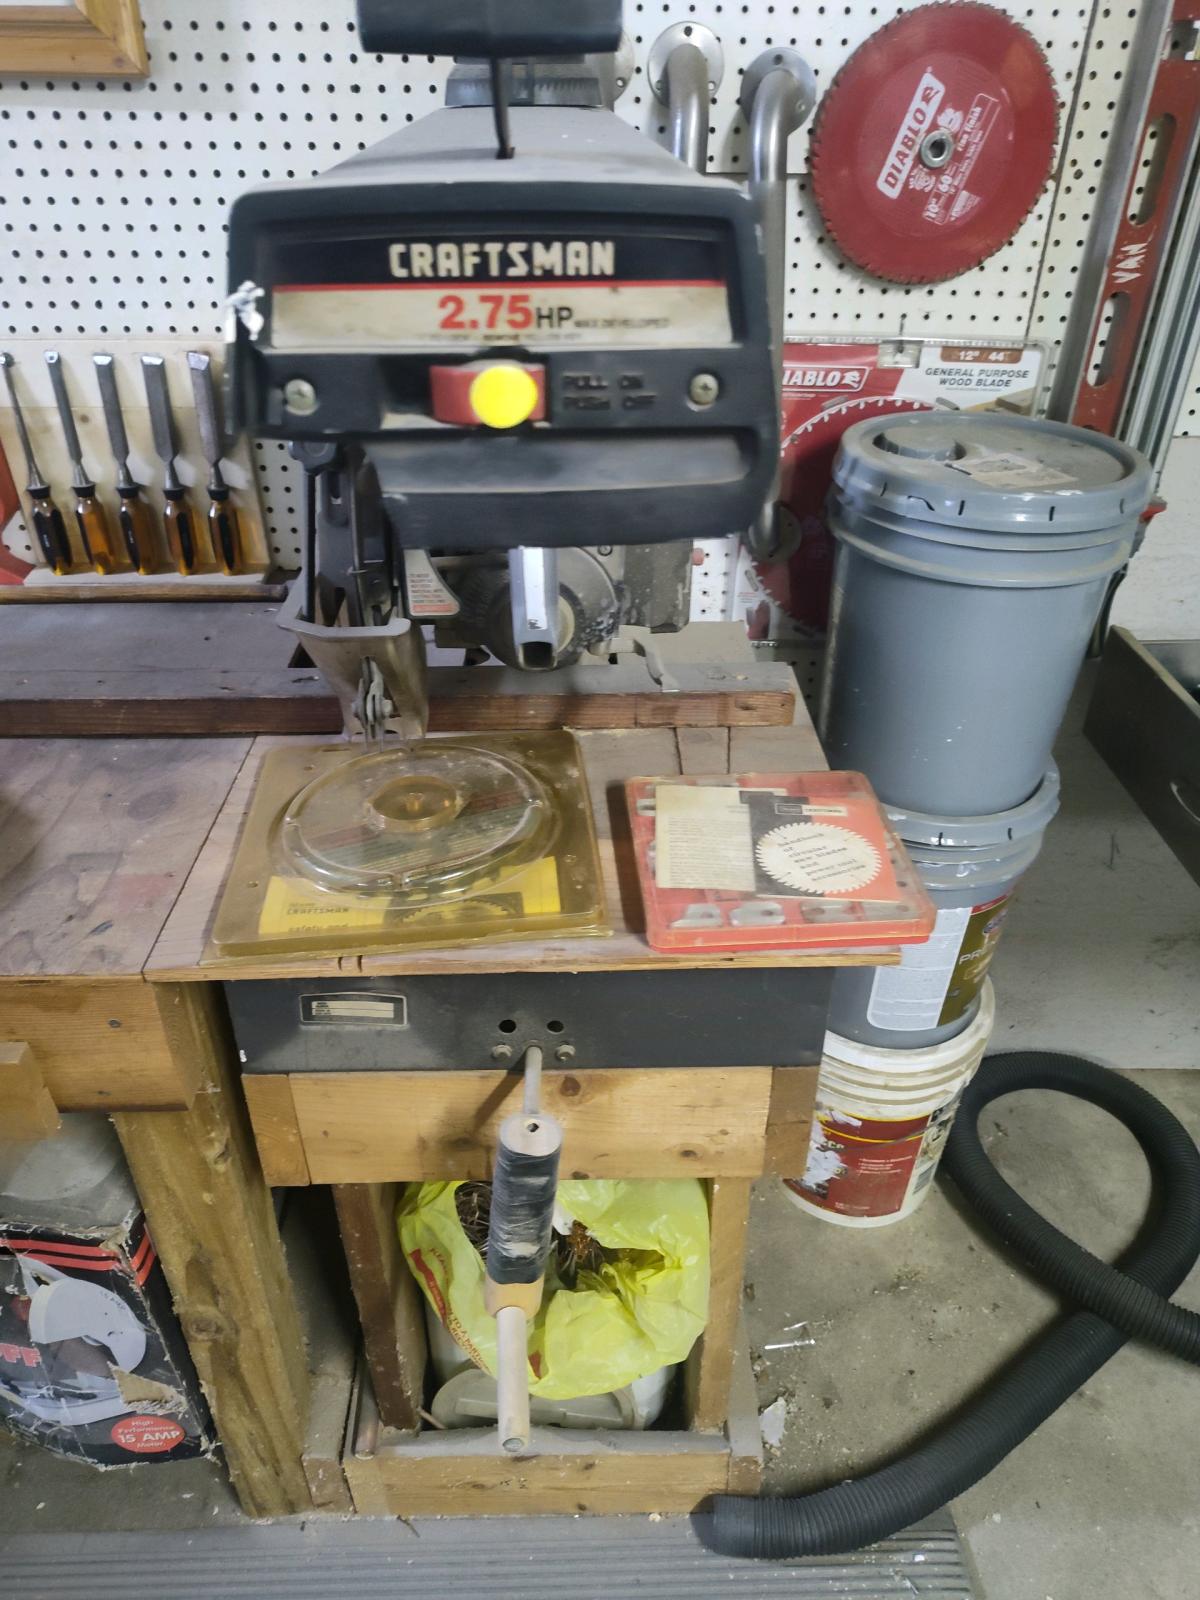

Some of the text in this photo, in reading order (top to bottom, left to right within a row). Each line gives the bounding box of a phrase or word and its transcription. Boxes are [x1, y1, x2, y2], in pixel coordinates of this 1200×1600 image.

[966, 106, 983, 130] Finish
[884, 107, 927, 189] DIABLO
[939, 175, 953, 193] 60
[388, 240, 615, 279] CRAFTSMAN
[438, 294, 534, 330] 2.75
[535, 305, 574, 330] HP
[781, 369, 842, 387] IABLO
[925, 367, 1030, 379] GENERAL PURPOSE
[939, 377, 1012, 388] WOOD BLADE
[0, 1342, 42, 1368] FF
[117, 1431, 180, 1444] 15 AMP
